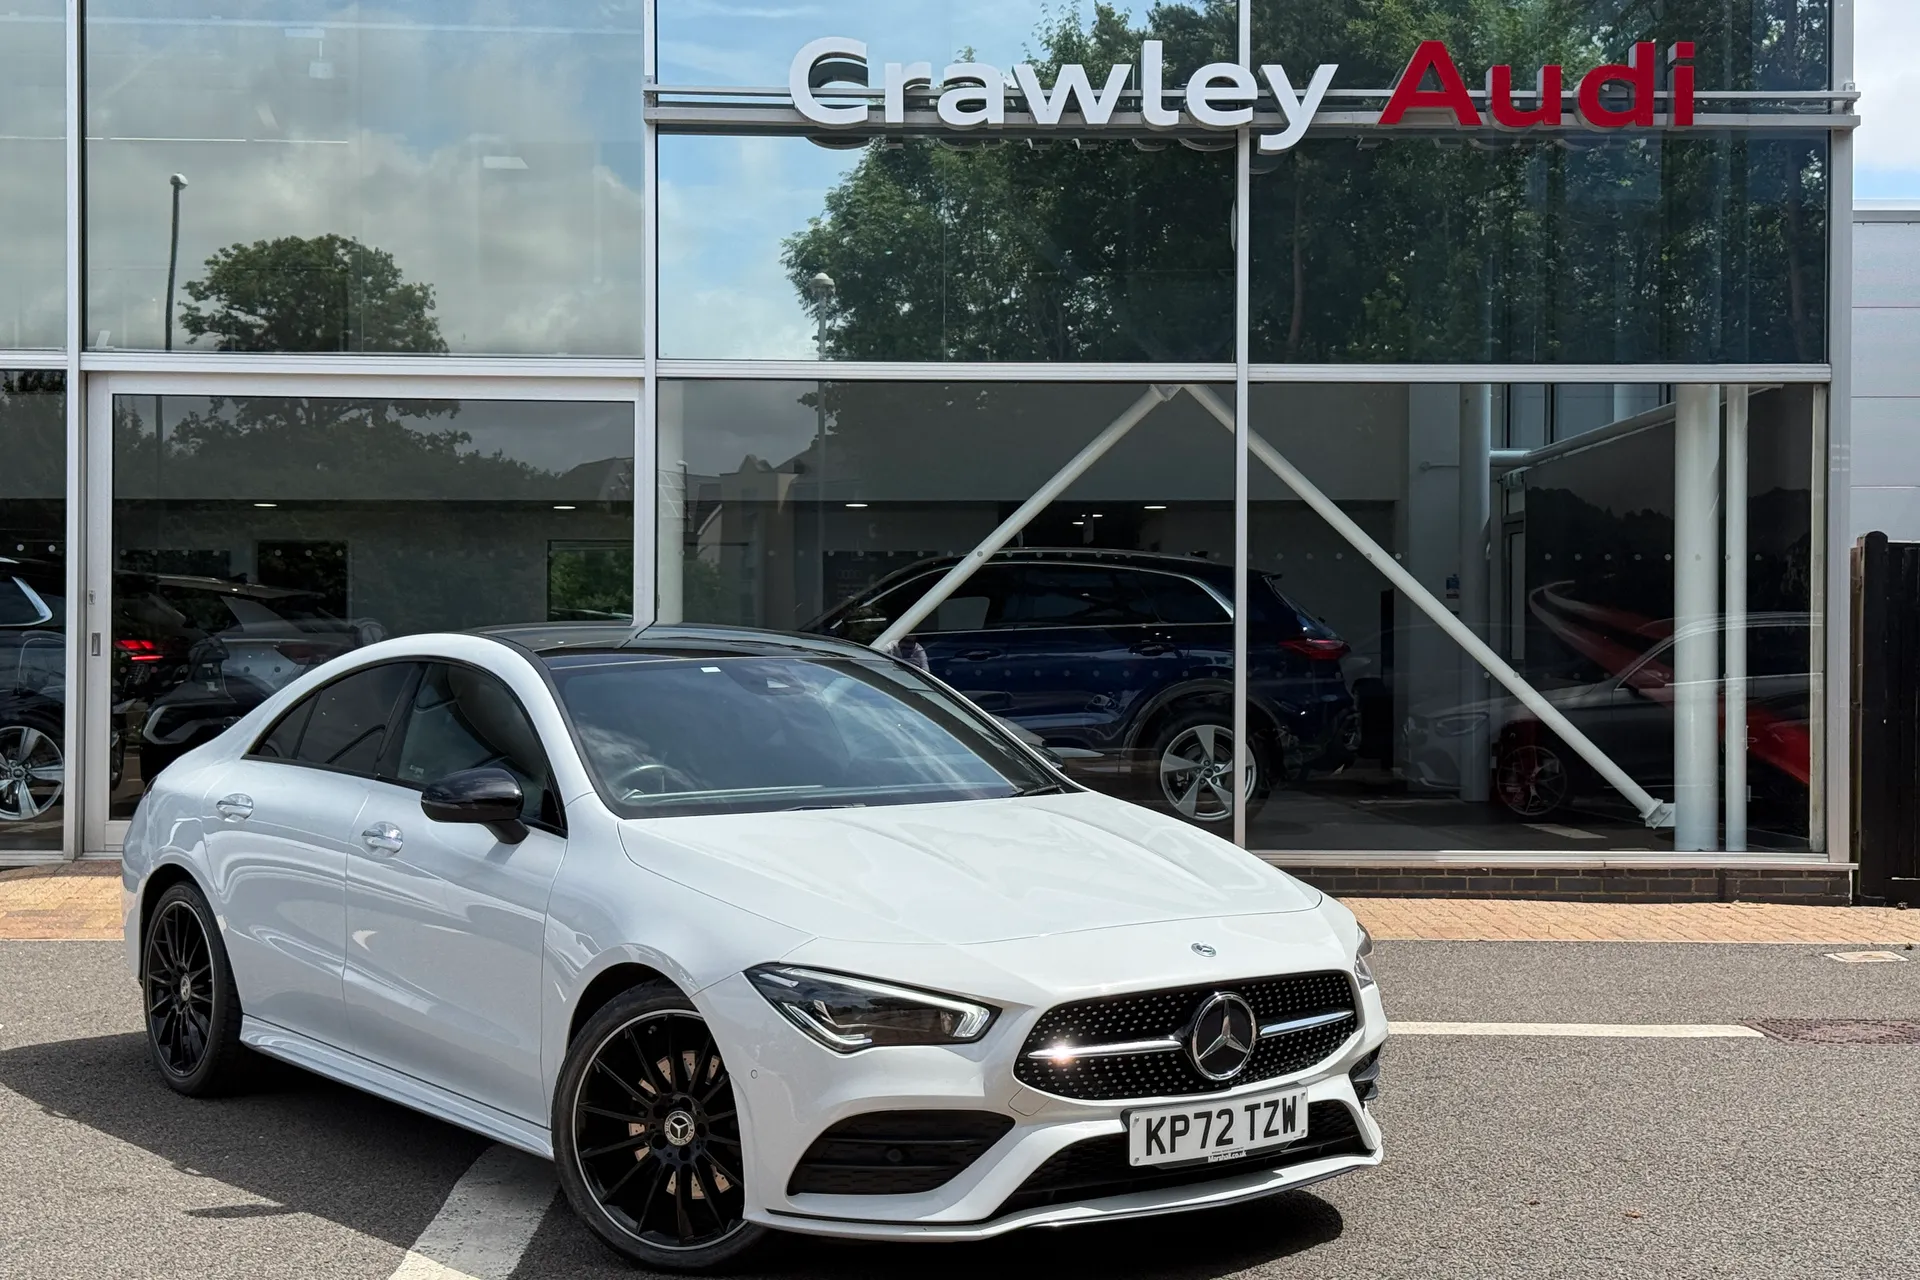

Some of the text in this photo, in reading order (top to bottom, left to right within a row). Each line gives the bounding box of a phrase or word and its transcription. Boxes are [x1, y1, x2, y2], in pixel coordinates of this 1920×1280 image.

[789, 36, 1695, 152] Crawley Audi
[1145, 1095, 1297, 1156] KP72 TZW
